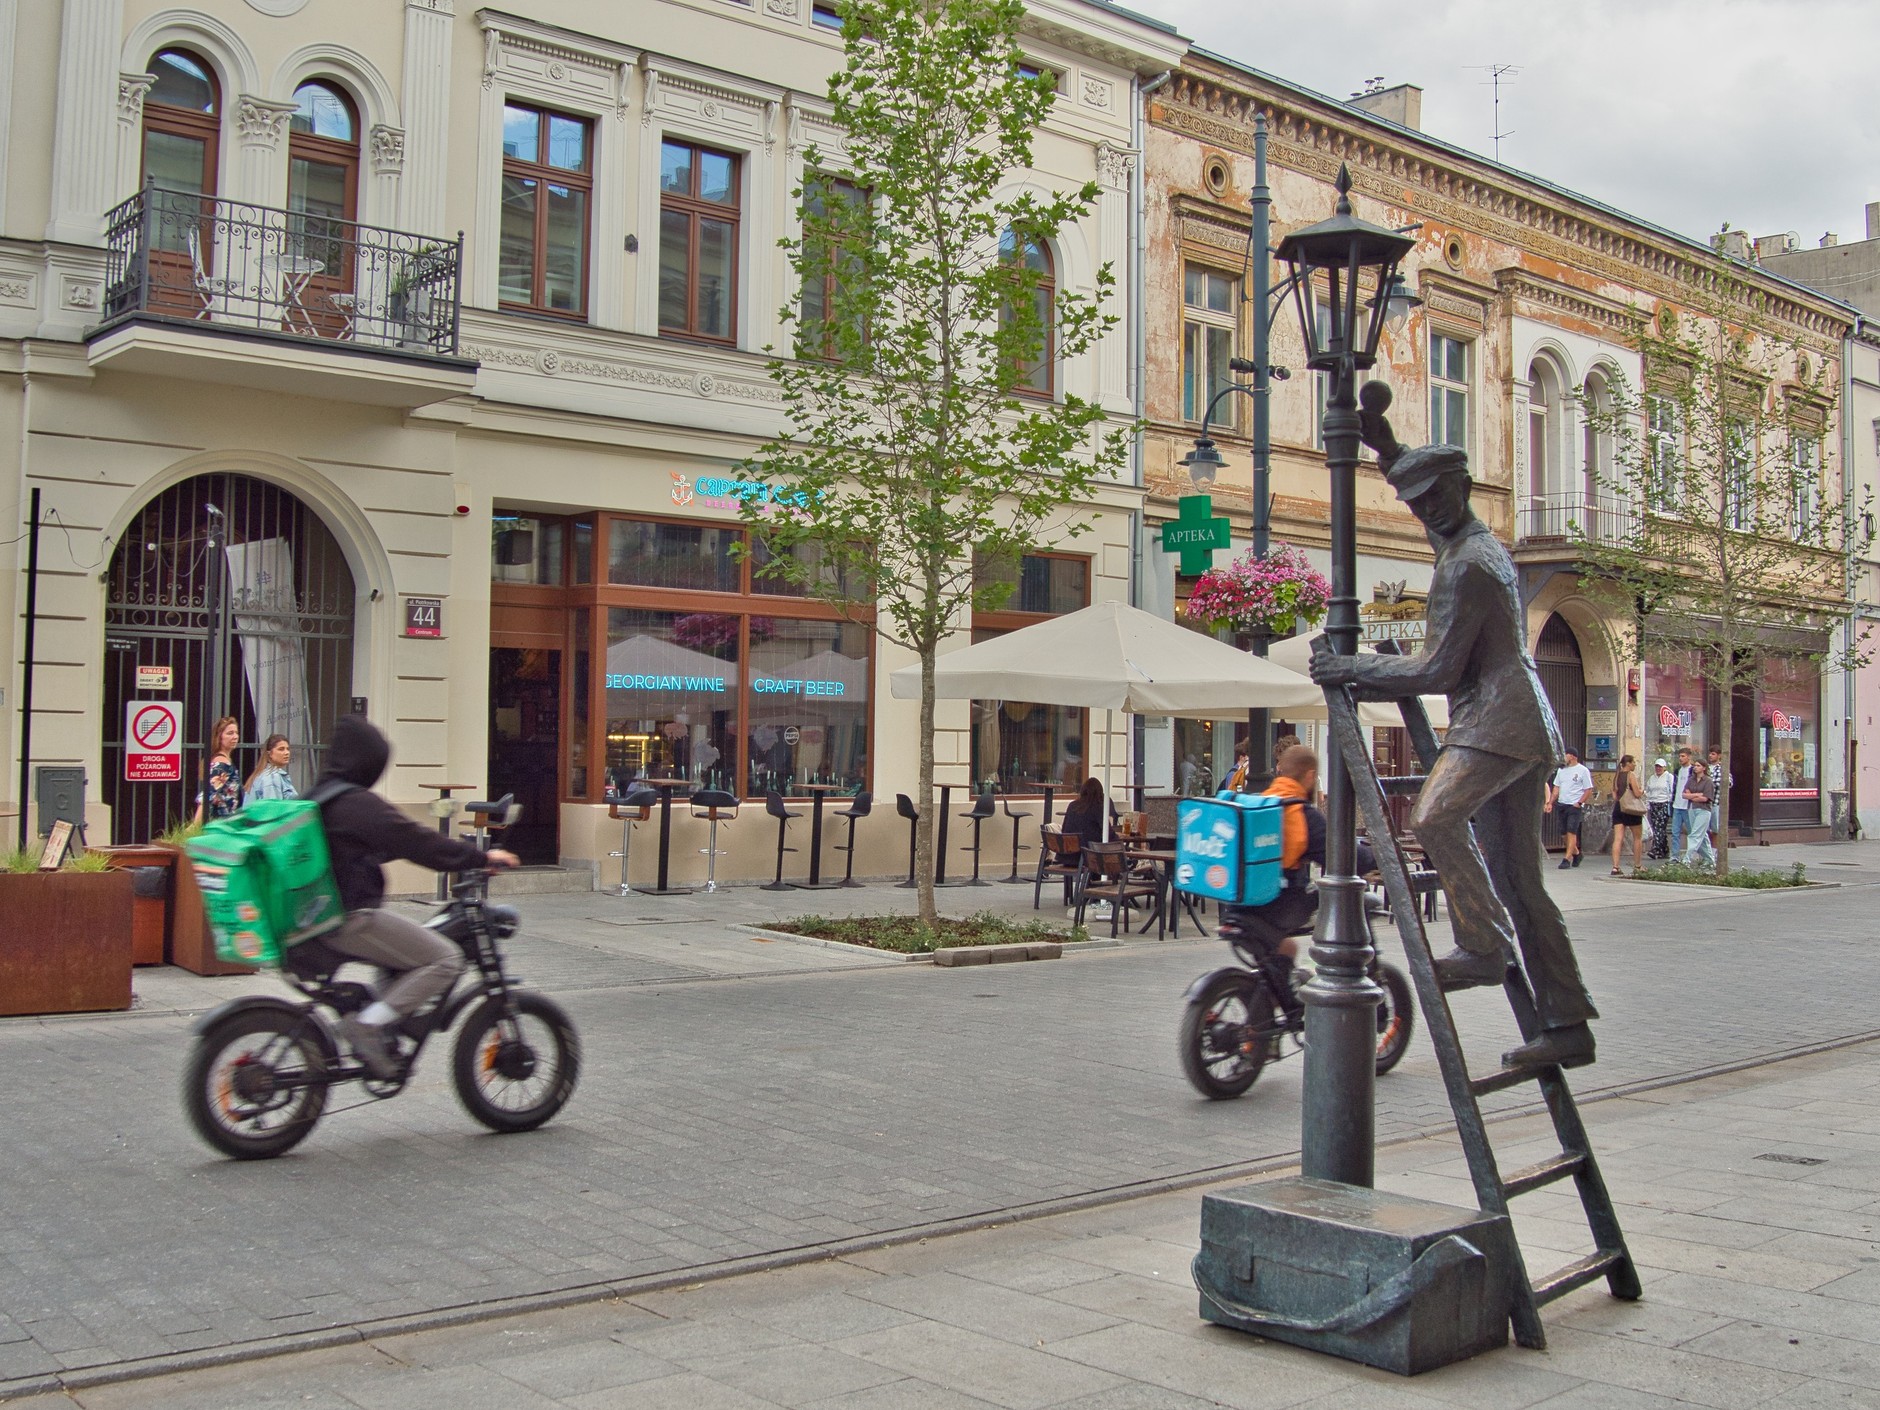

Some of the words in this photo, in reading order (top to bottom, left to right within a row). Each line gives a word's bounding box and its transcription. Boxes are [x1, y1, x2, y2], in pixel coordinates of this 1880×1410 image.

[1168, 528, 1215, 543] APTEKA
[413, 607, 435, 625] 44
[606, 674, 682, 691] GEORGIAN
[685, 676, 725, 692] WINE
[754, 678, 803, 695] CRAFT
[806, 680, 845, 696] BEER
[136, 762, 171, 770] POŻAROWA
[142, 770, 177, 778] ZASTAWIAĆ
